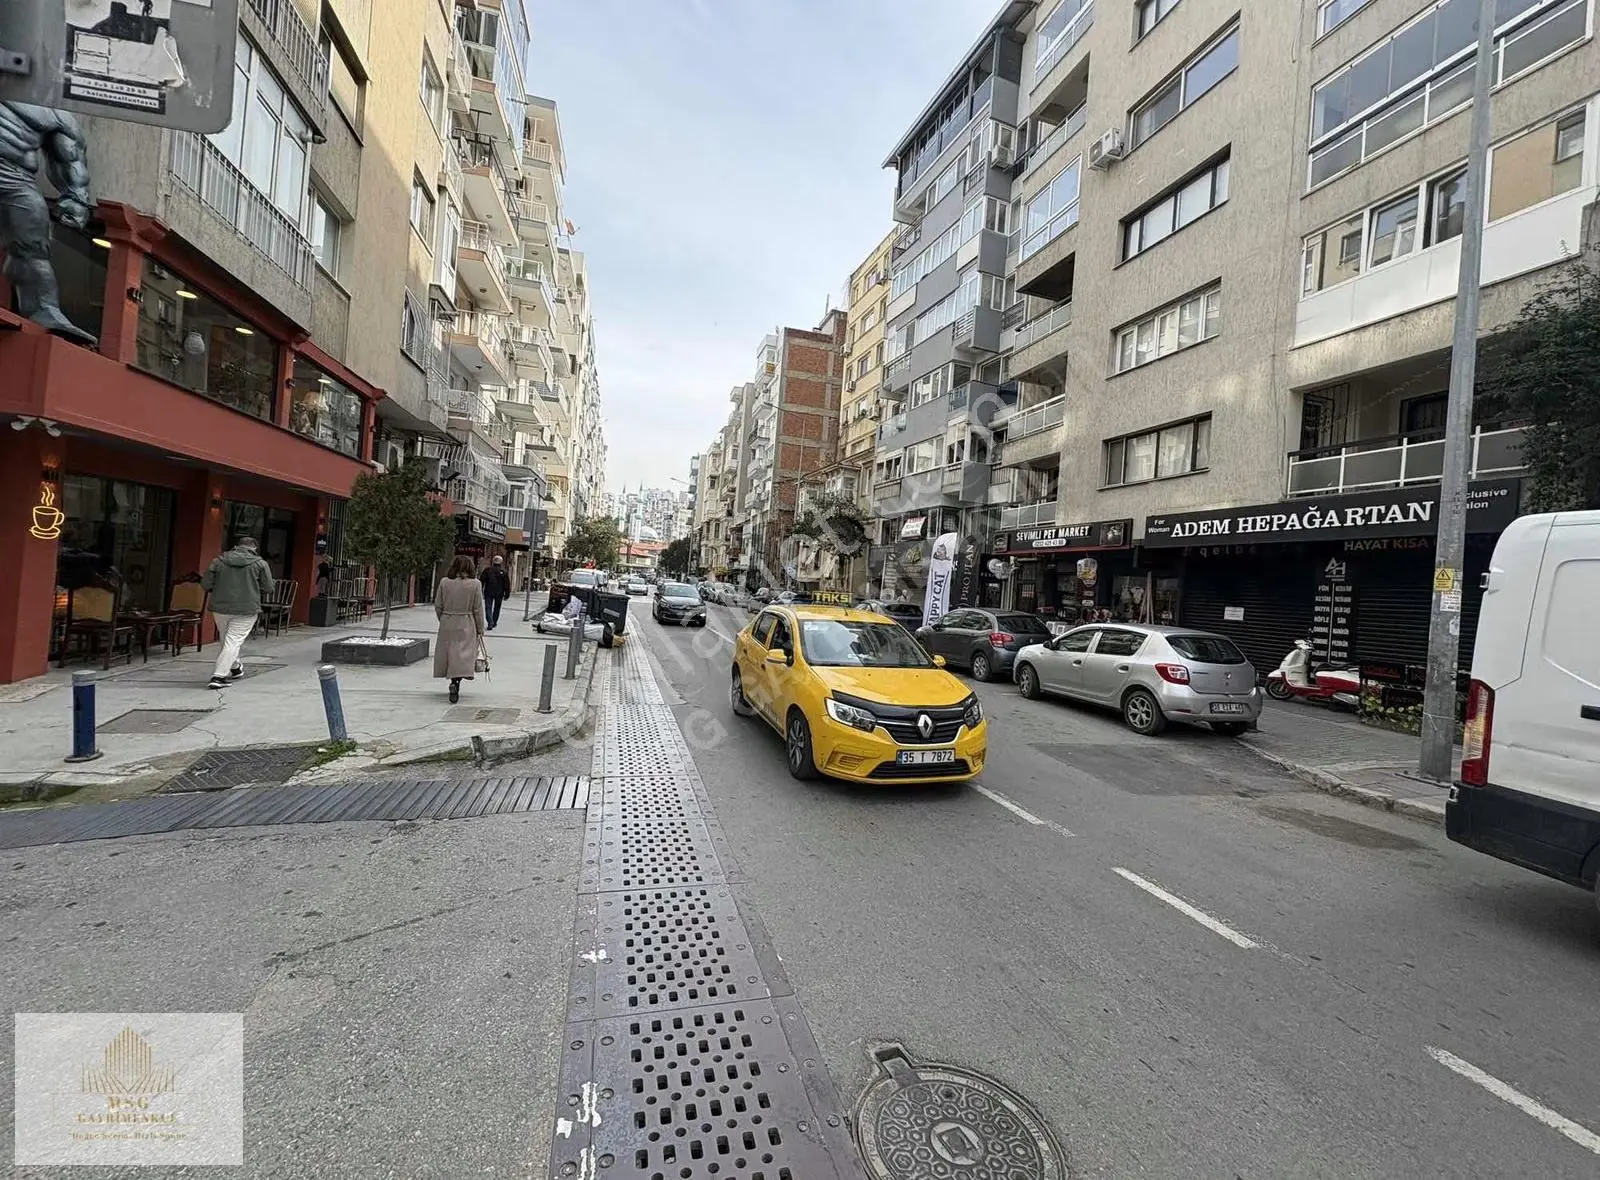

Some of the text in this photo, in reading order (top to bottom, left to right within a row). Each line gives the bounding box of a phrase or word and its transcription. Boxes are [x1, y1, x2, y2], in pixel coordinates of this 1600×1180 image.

[1465, 488, 1508, 500] clusive
[1466, 500, 1489, 510] lon
[1170, 500, 1434, 538] ADEM HEPAĞARTAN
[1043, 529, 1057, 540] PET
[1058, 526, 1090, 538] MARKET
[1343, 536, 1429, 552] HAYAT KISA
[960, 544, 975, 601] PRO PLAN
[932, 571, 946, 595] CAT
[903, 751, 953, 763] 35 T 7872
